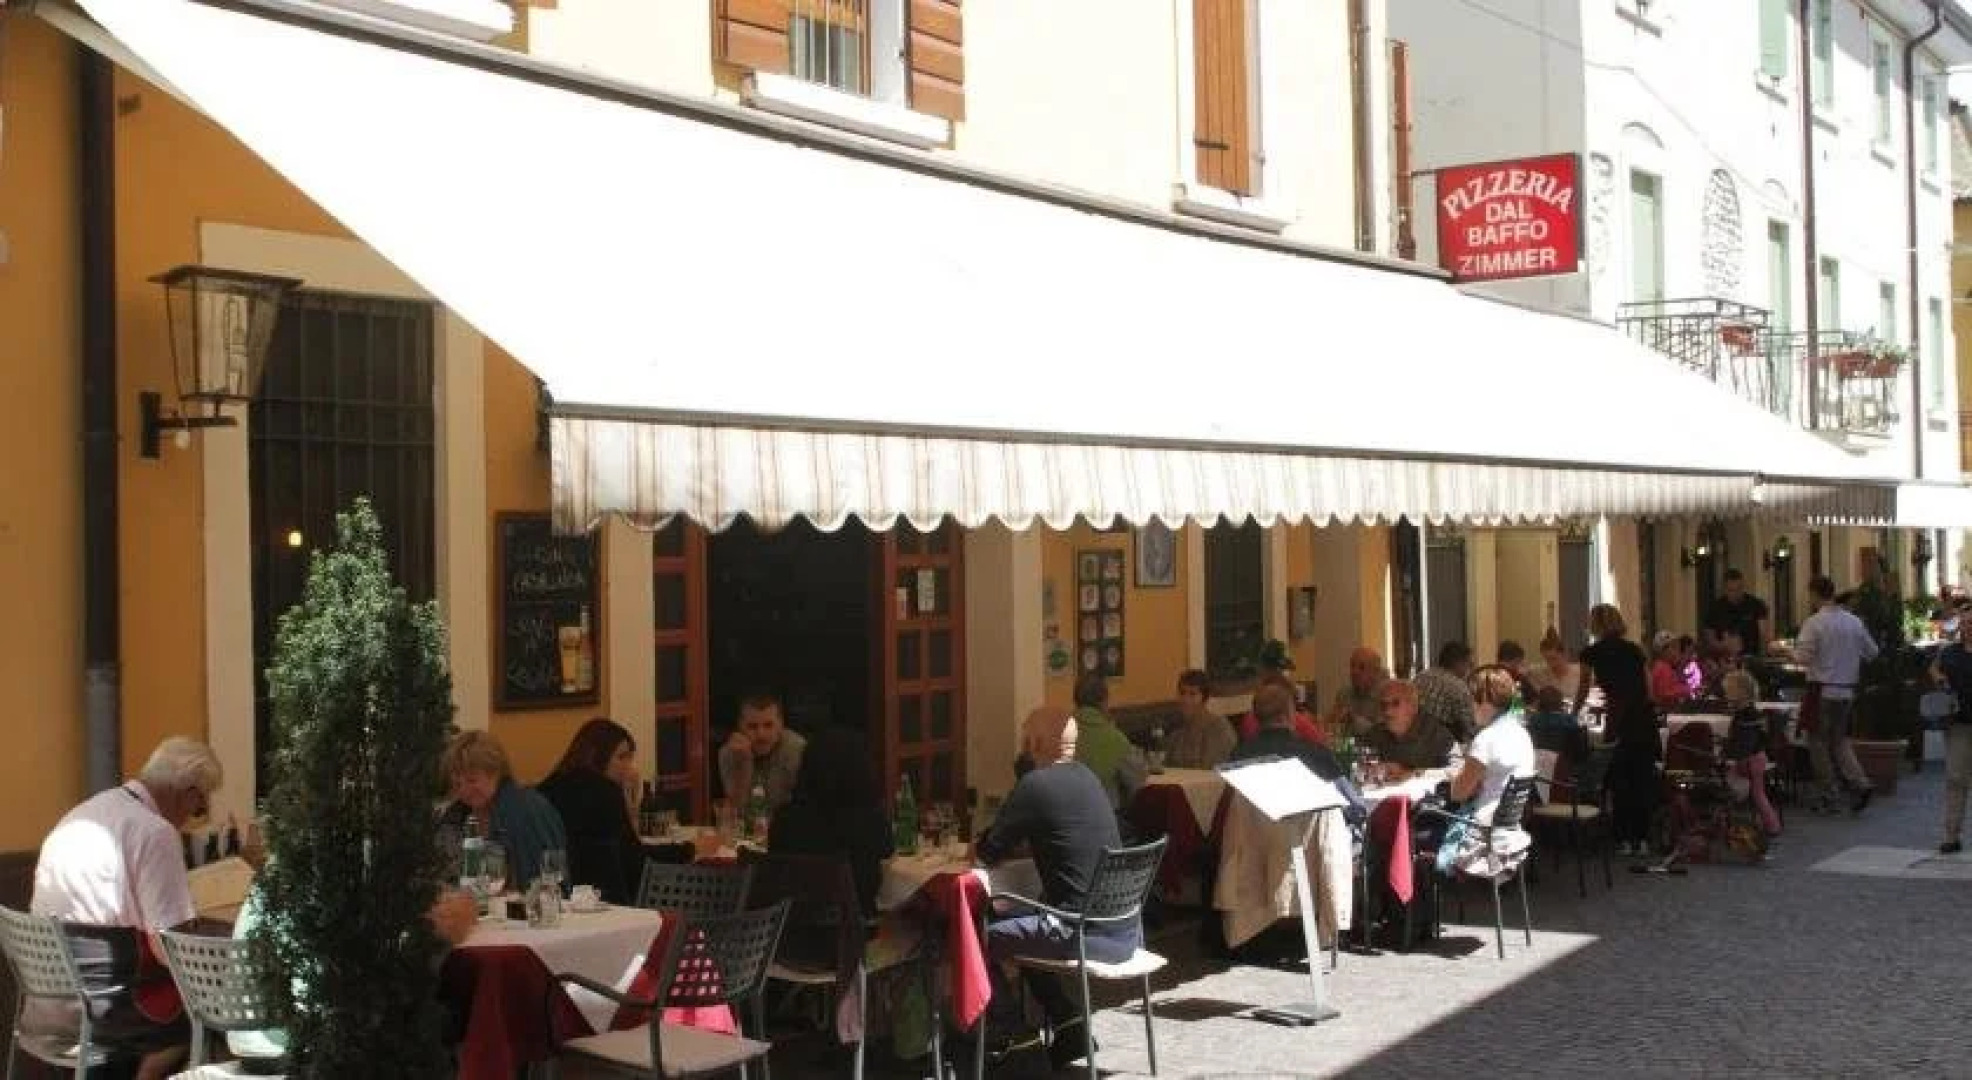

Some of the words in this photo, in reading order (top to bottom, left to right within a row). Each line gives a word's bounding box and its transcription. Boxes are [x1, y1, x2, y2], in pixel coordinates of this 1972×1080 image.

[1443, 169, 1573, 219] PIZZERIA
[1486, 200, 1533, 222] DAL
[1467, 220, 1548, 247] BAFFO
[1458, 247, 1557, 275] ZIMMER
